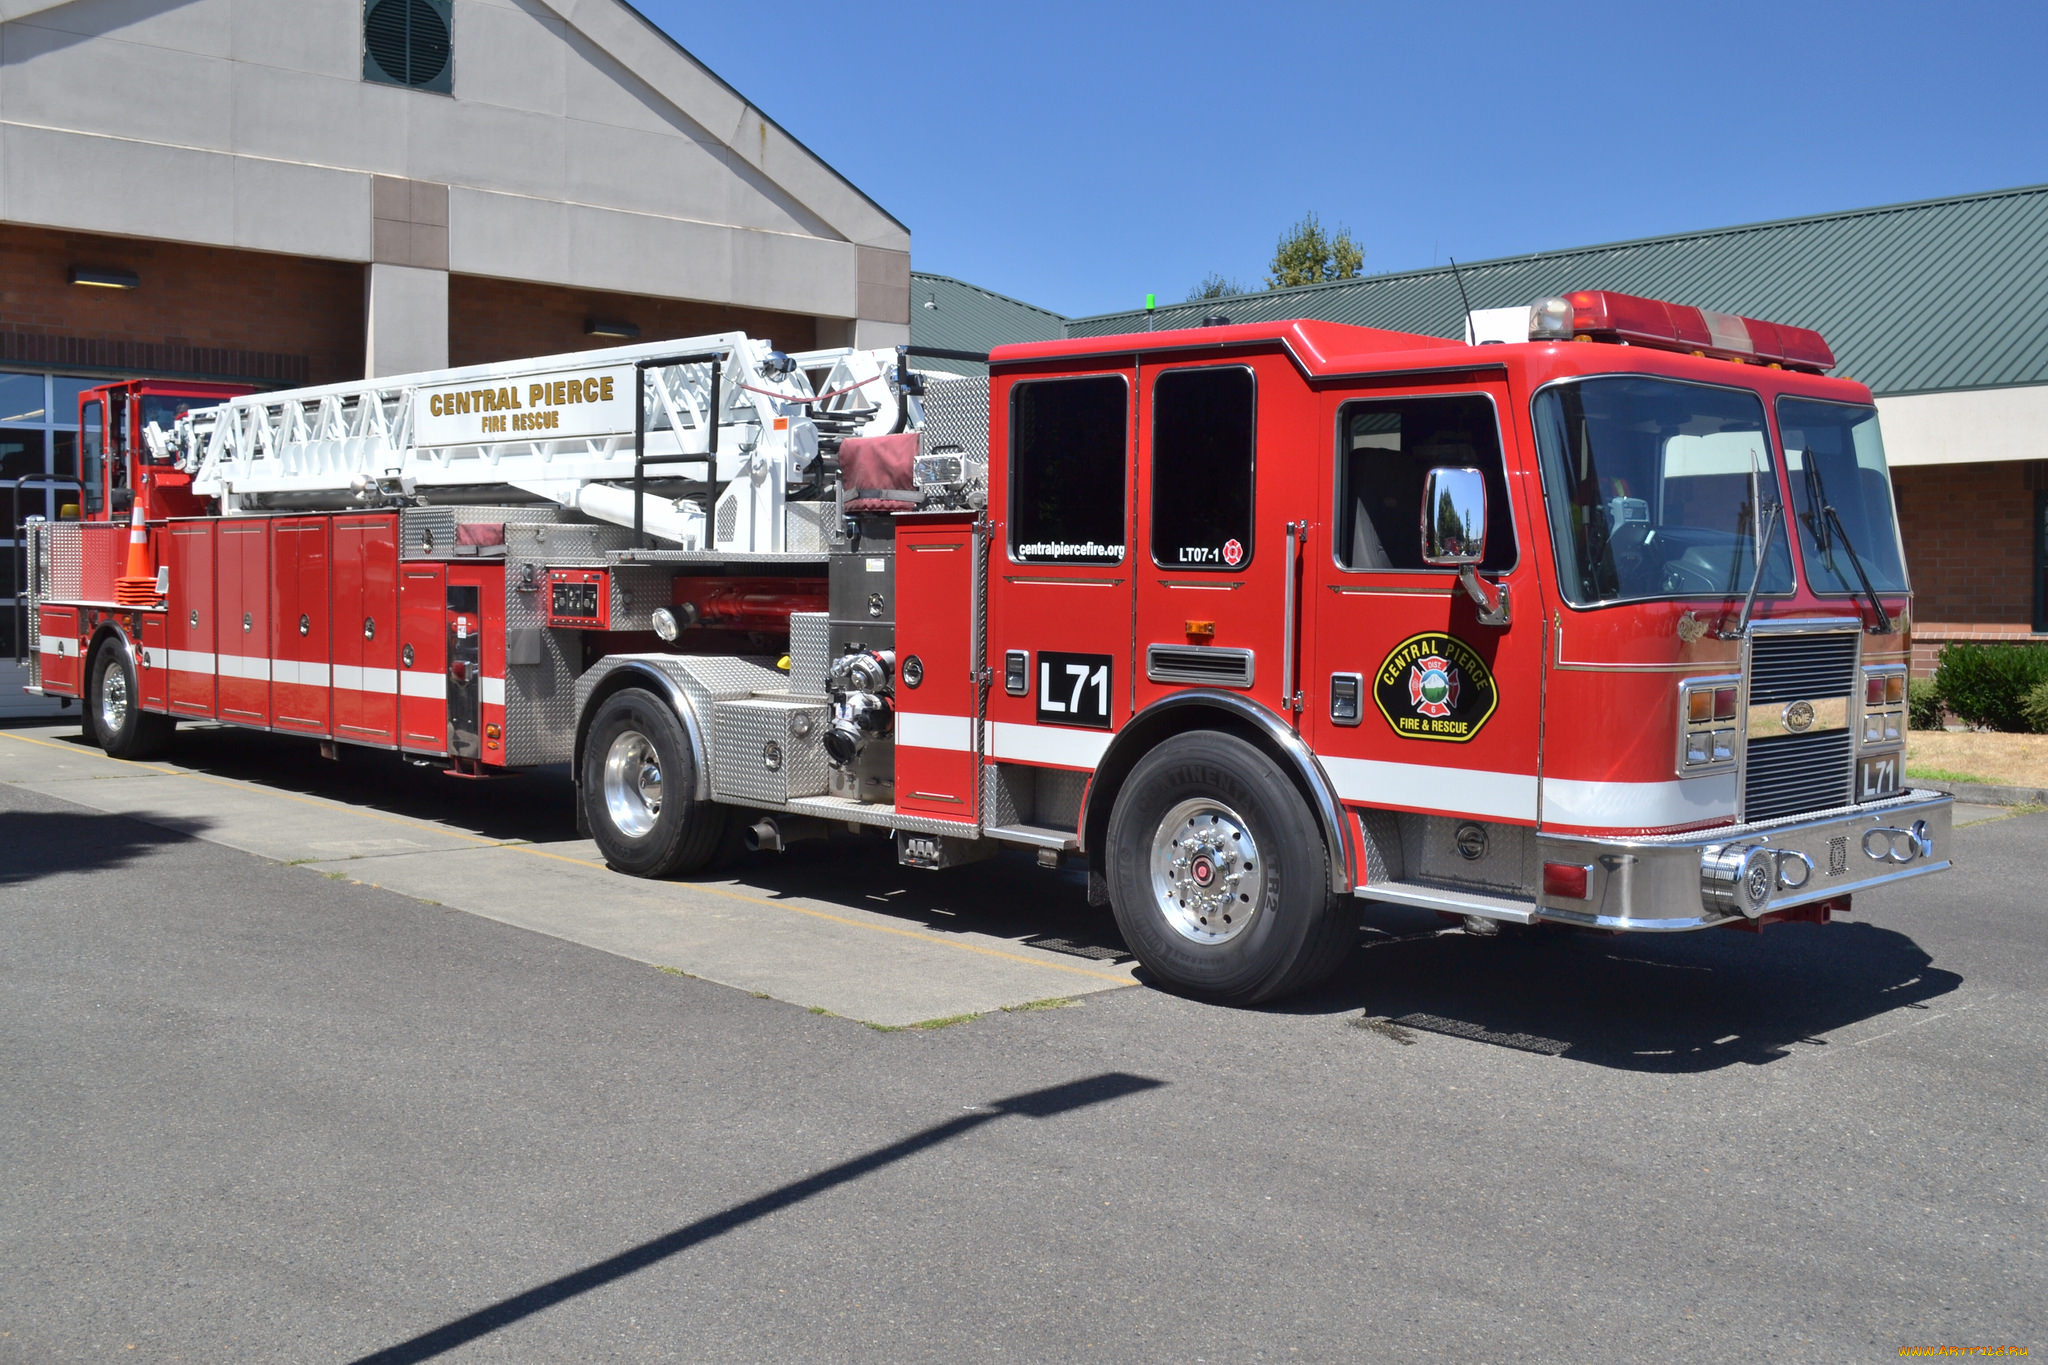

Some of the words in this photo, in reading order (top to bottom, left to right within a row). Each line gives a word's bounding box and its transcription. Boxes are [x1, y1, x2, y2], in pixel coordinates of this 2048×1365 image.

[430, 386, 521, 417] CENTRAL
[529, 376, 614, 407] PIERCE
[482, 415, 507, 433] FIRE
[512, 410, 559, 431] RESCUE
[1018, 541, 1125, 559] centralpiercefire.org
[1179, 547, 1219, 562] LT07-1
[1383, 640, 1438, 686] CENTRAL
[1445, 643, 1489, 691] PIERCE
[1040, 662, 1107, 716] L71
[1430, 705, 1437, 714] 6
[1399, 717, 1420, 730] FIRE
[1421, 719, 1430, 731] &
[1431, 720, 1468, 734] RESCUE
[1863, 760, 1894, 797] L71
